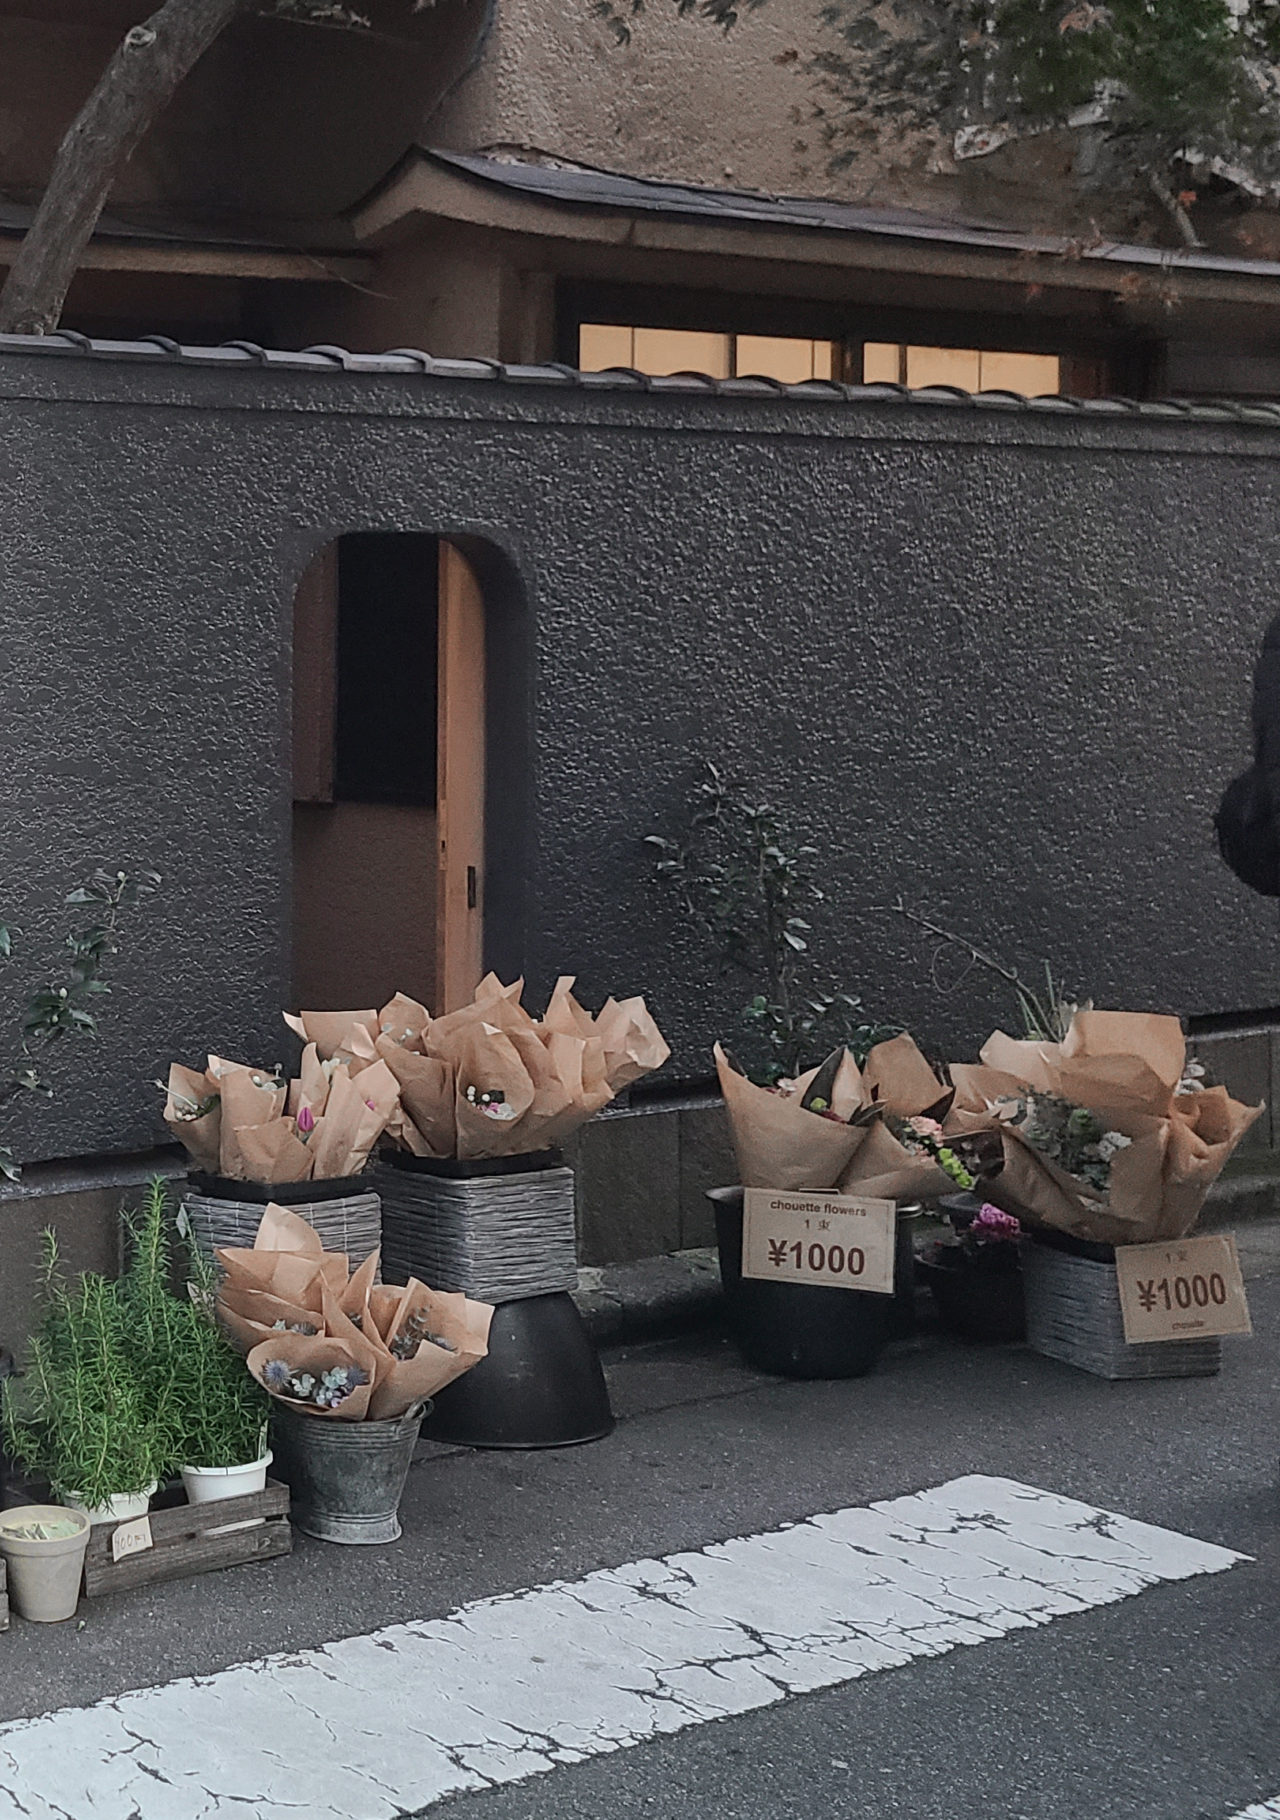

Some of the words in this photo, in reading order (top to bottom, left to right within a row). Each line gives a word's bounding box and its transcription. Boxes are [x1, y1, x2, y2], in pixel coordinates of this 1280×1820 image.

[770, 1199, 821, 1213] chouette
[824, 1203, 867, 1217] flowers
[767, 1238, 865, 1276] ¥1000
[1136, 1273, 1226, 1313] ¥1000
